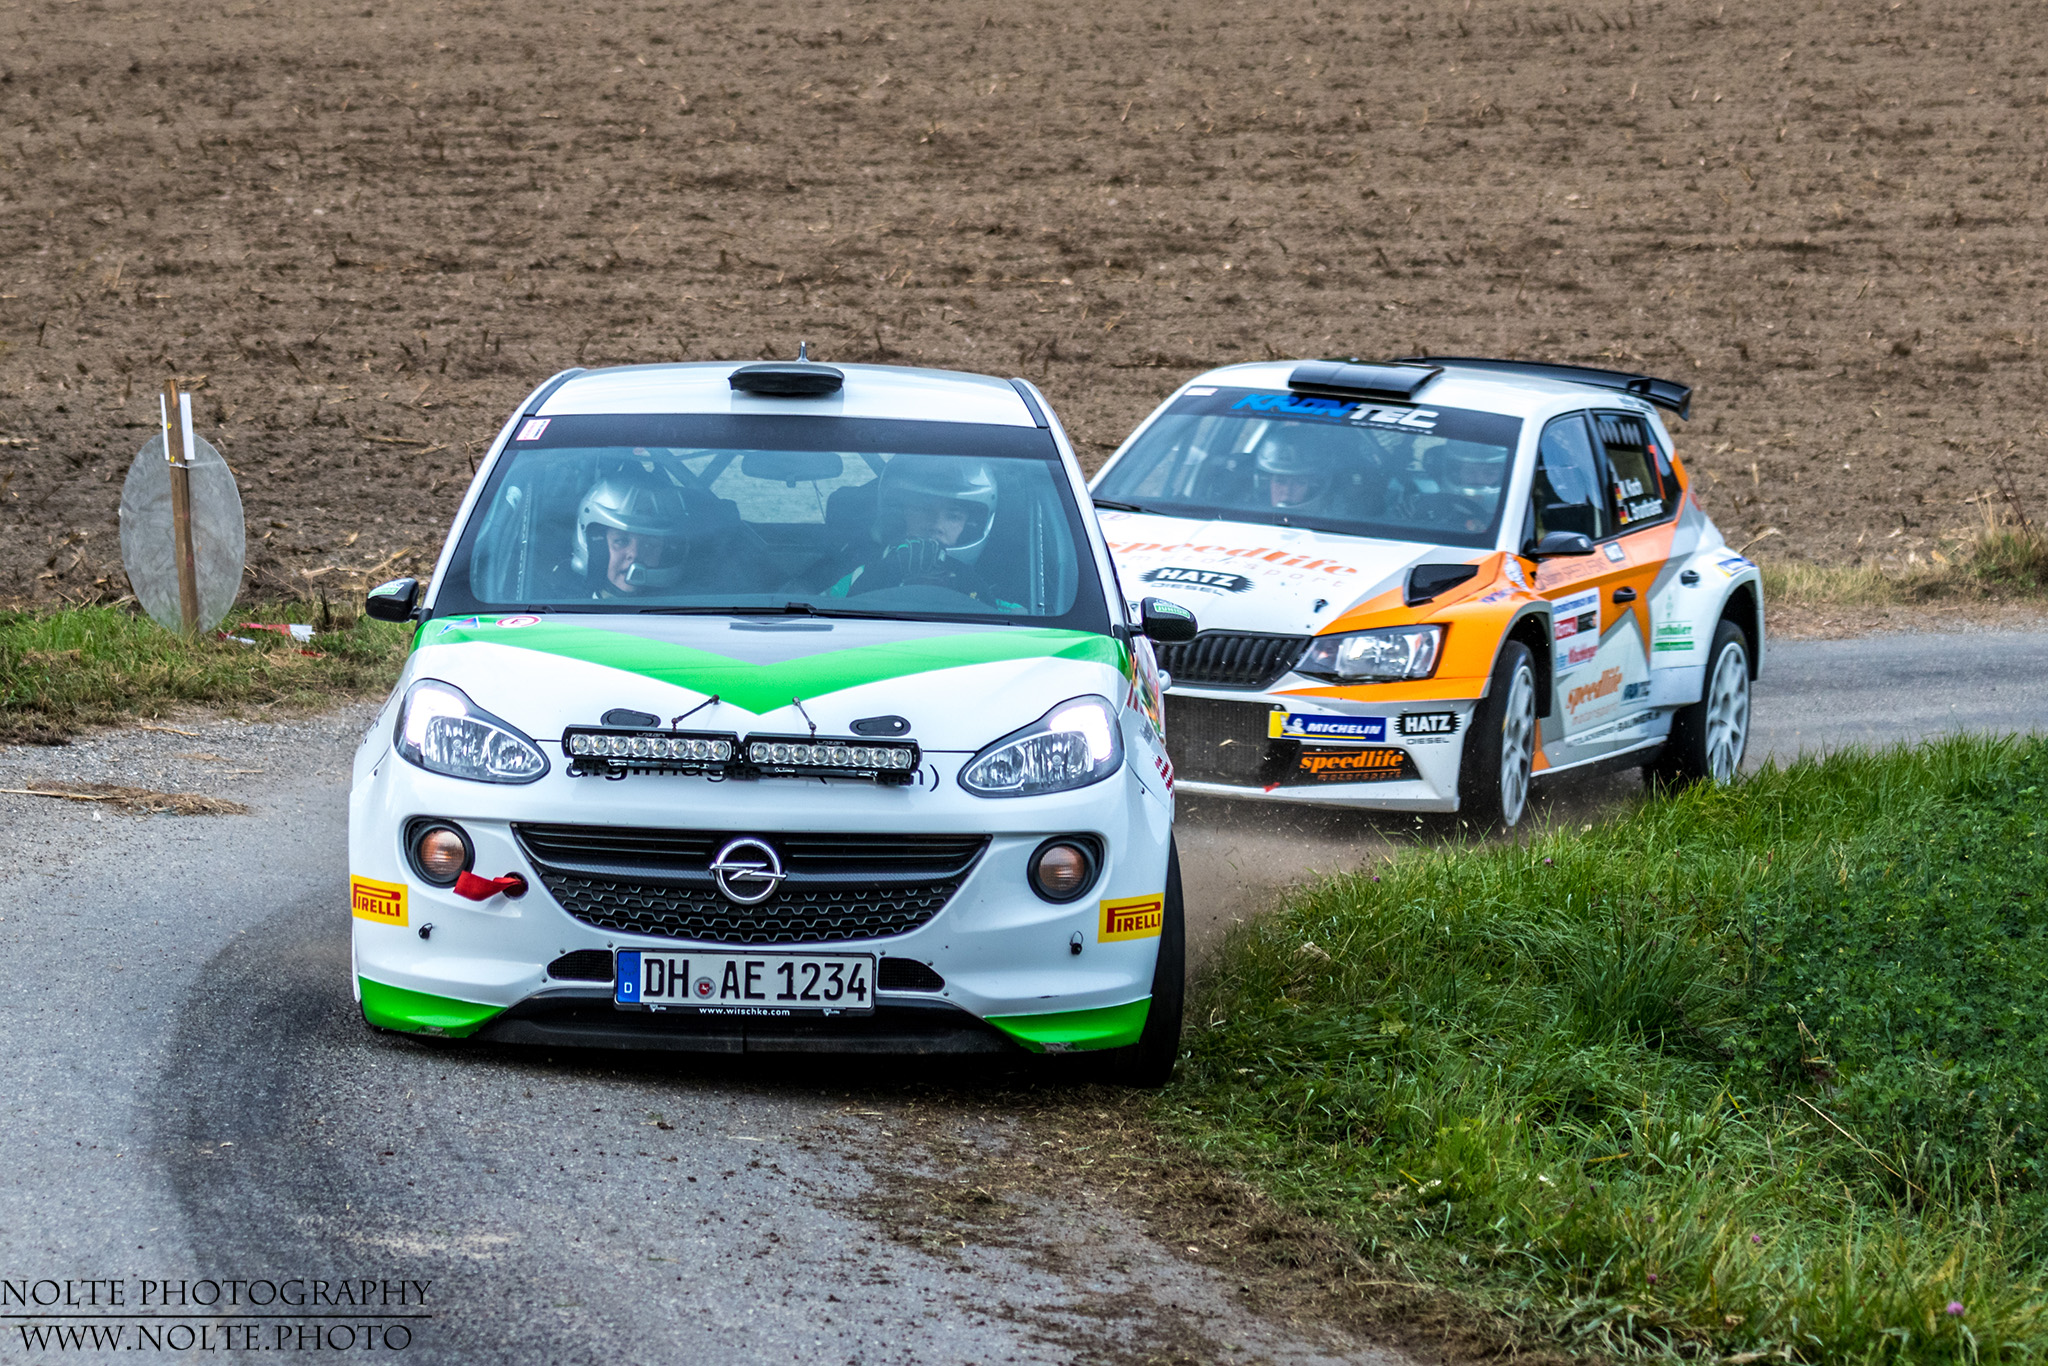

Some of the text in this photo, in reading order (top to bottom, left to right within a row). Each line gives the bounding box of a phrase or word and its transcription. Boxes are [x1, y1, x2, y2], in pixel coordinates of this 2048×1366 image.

[1156, 568, 1236, 588] HATZ
[1151, 583, 1225, 597] DIESEL
[1306, 723, 1383, 735] MICHELIN
[1404, 715, 1452, 733] HATZ
[1406, 737, 1451, 745] DIESEL
[1299, 750, 1404, 773] speedlife
[1317, 771, 1402, 781] motorsport
[353, 883, 402, 917] PIRELLI
[1106, 901, 1162, 934] PIRELLI
[623, 958, 868, 1002] D DH AE 1234
[698, 1007, 791, 1017] www.witschke.com
